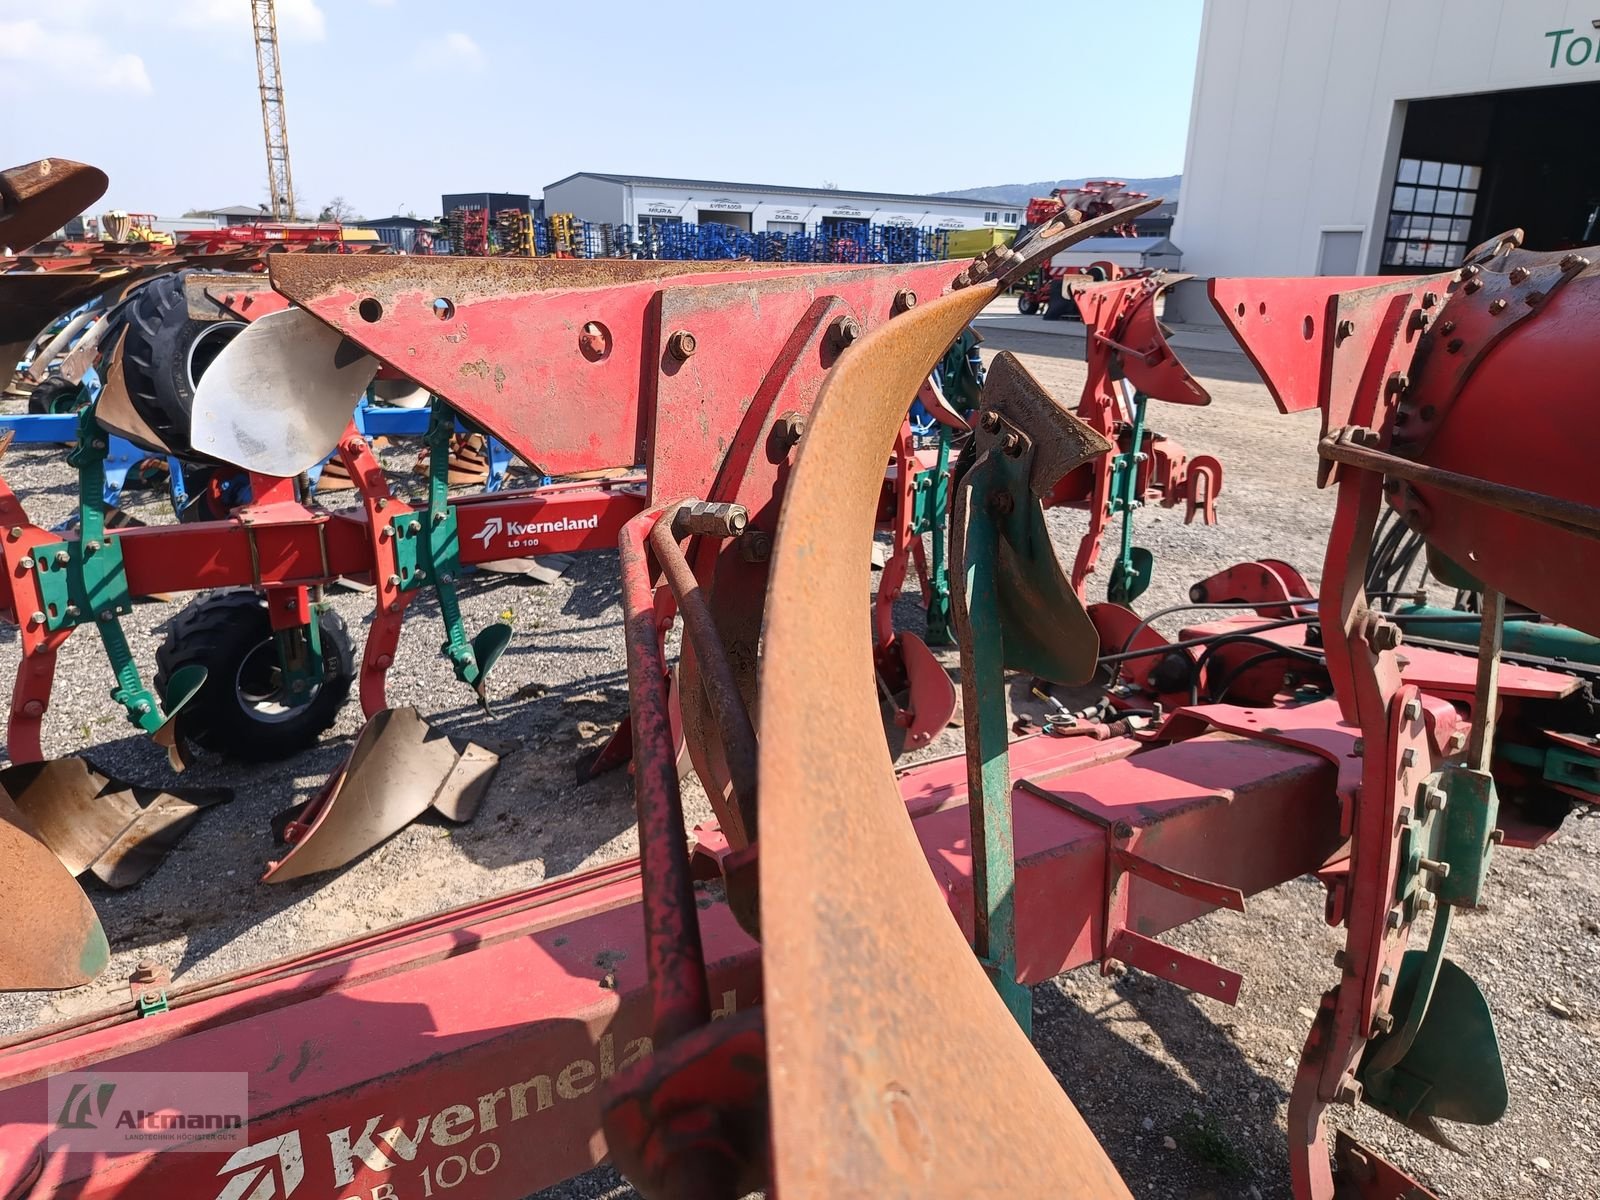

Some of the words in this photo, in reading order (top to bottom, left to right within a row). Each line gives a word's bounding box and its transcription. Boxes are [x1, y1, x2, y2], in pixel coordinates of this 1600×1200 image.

[1545, 28, 1600, 69] To
[506, 514, 598, 536] Kverneland
[508, 540, 520, 548] LD
[522, 538, 539, 546] 100
[326, 989, 736, 1190] Kvernelad
[418, 1141, 501, 1198] 100
